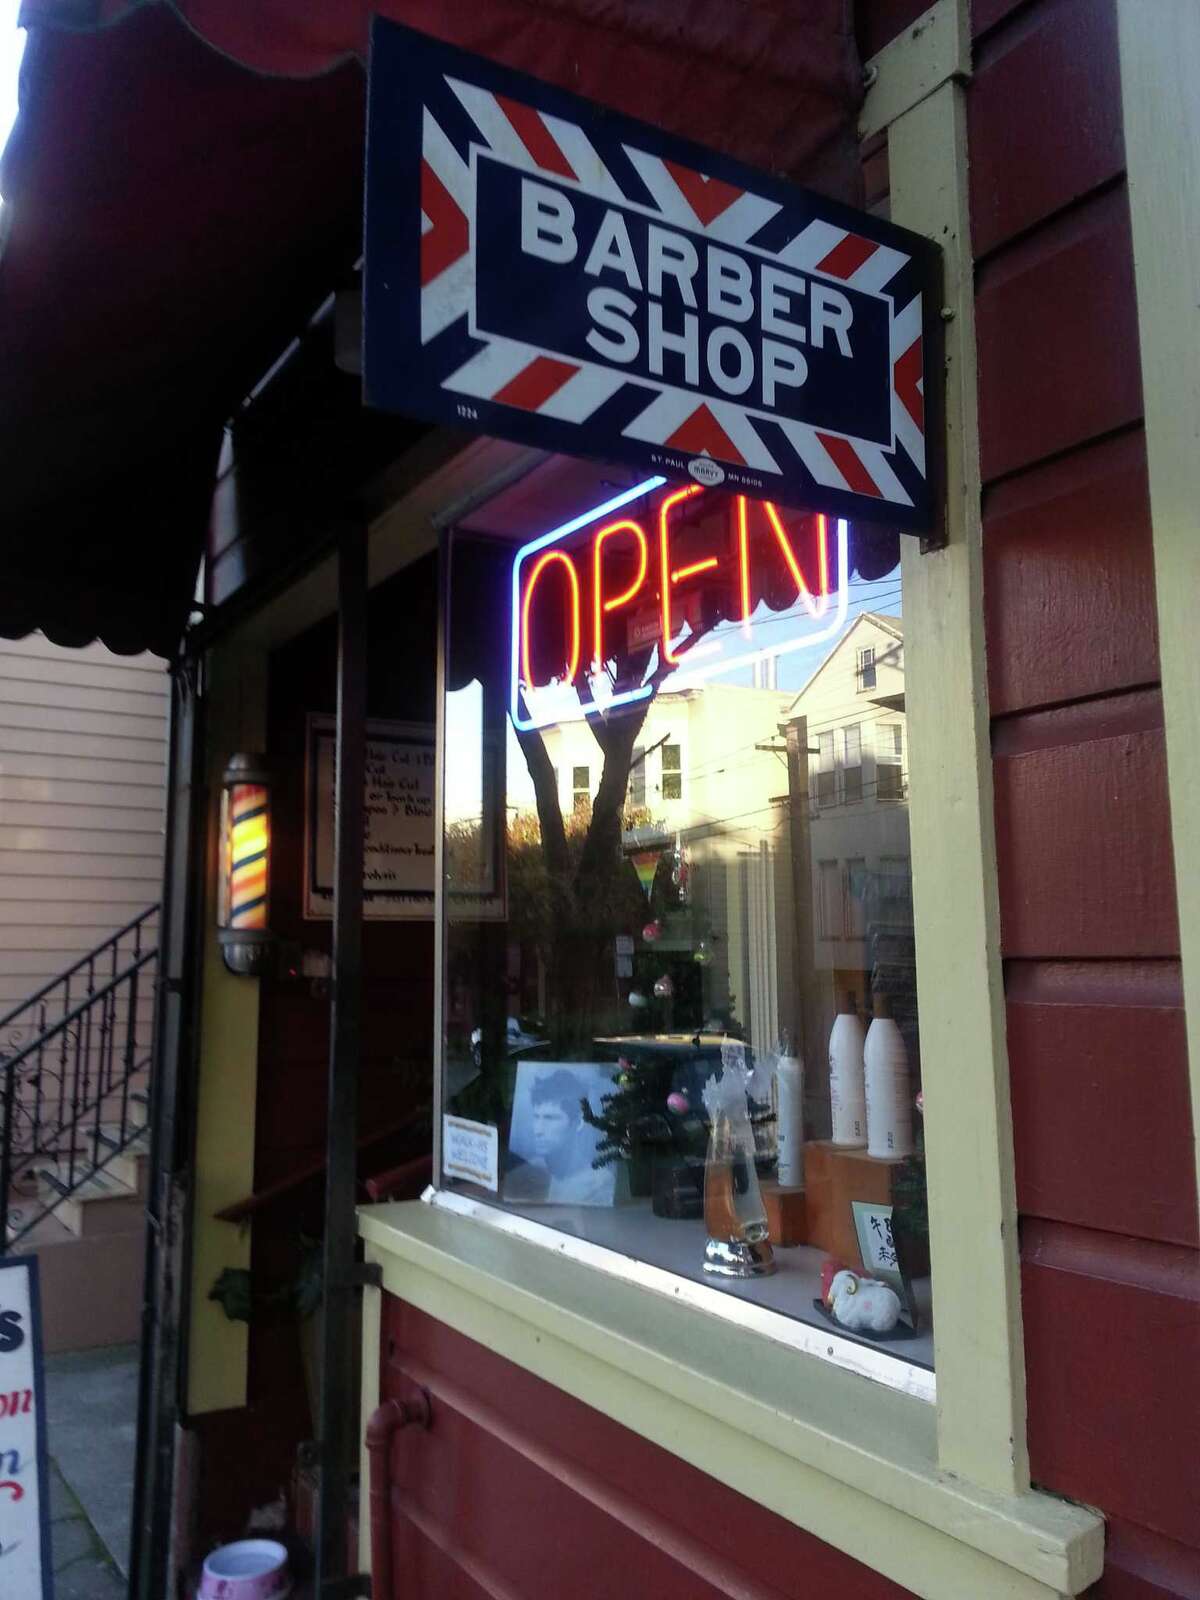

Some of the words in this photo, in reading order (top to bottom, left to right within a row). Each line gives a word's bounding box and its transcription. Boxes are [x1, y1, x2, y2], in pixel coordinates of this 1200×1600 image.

[521, 177, 853, 359] BARBER
[586, 286, 808, 407] SHOP
[457, 405, 478, 420] 1224
[665, 456, 686, 469] PAUL
[728, 472, 740, 483] MN
[522, 484, 829, 692] OPEN
